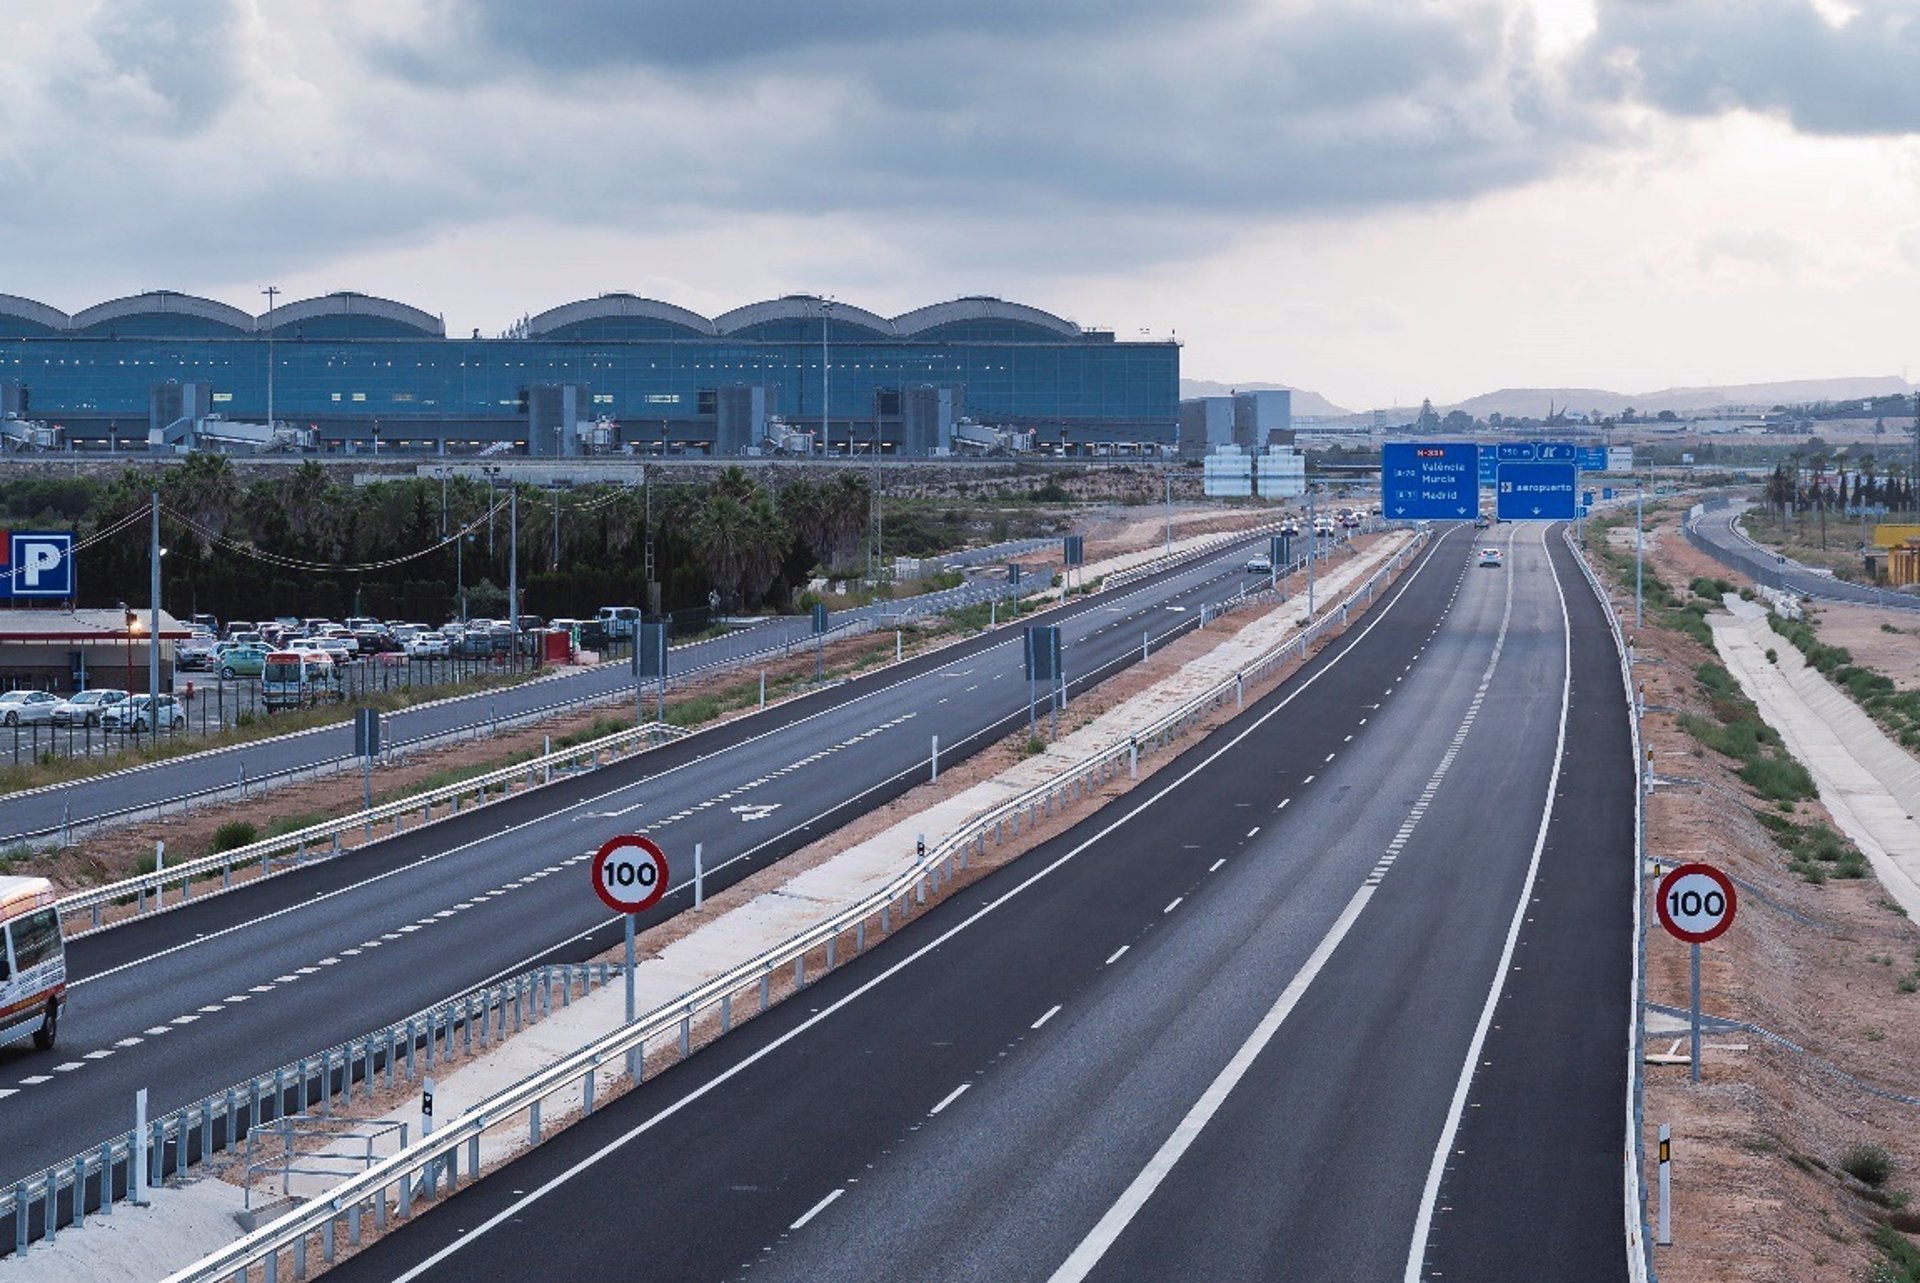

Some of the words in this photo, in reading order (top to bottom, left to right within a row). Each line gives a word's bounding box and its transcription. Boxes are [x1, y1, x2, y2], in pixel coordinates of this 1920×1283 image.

[1422, 474, 1456, 483] Murcia
[1422, 491, 1458, 500] Madrid
[1516, 484, 1573, 493] aeropuerto
[24, 543, 61, 586] P
[603, 861, 657, 887] 100
[1669, 890, 1726, 917] 100
